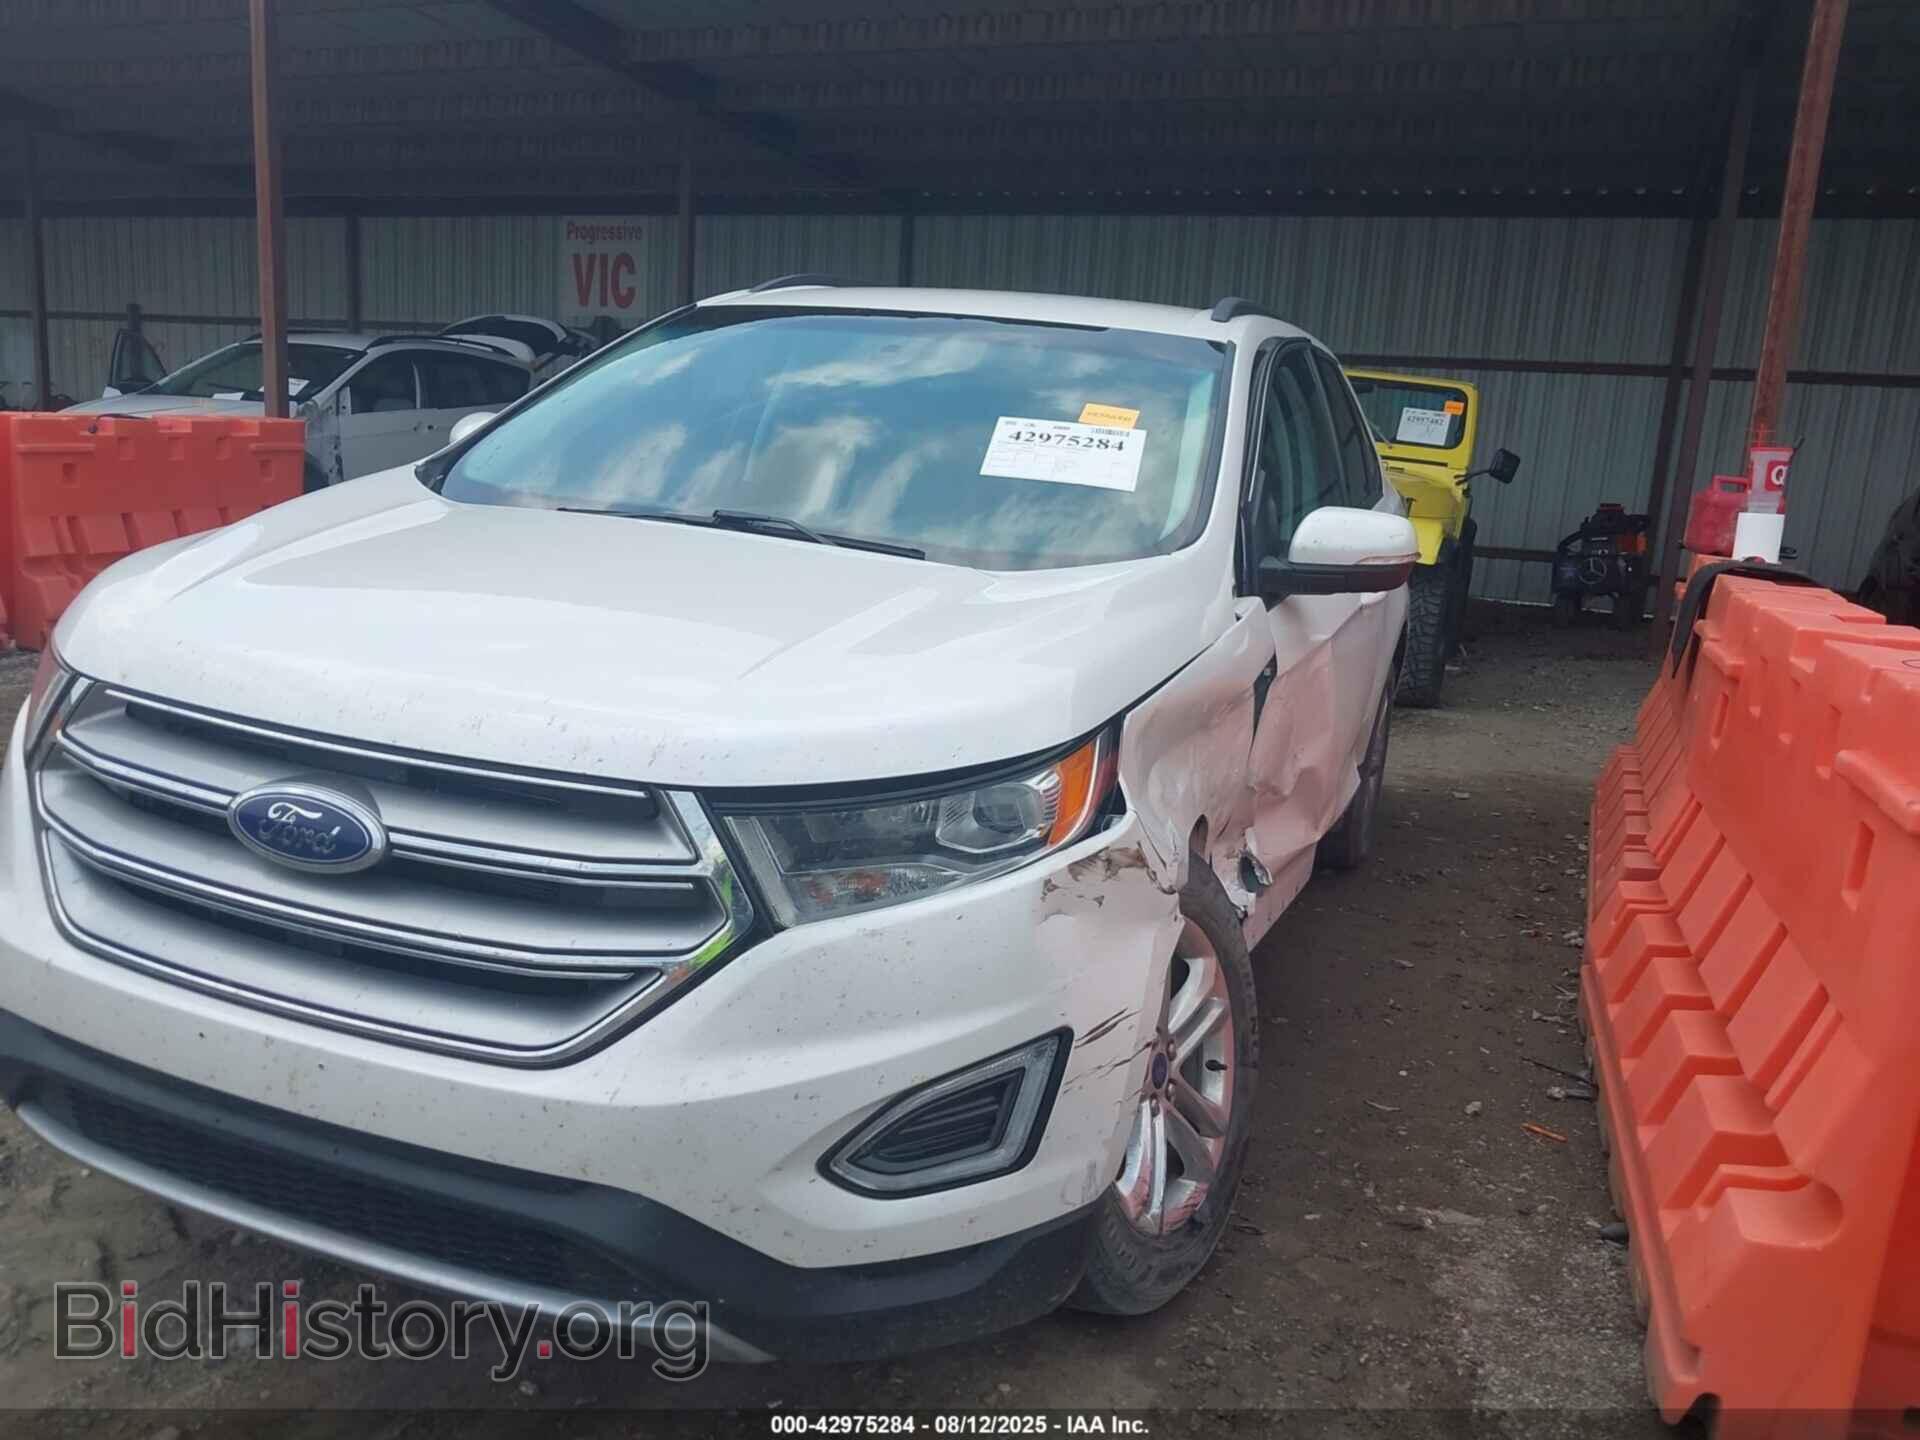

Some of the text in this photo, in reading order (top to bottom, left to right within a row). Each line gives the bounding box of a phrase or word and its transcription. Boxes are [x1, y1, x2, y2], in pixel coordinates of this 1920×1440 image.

[572, 252, 637, 309] VIC
[1008, 430, 1125, 452] 42975284
[258, 801, 342, 854] Ford
